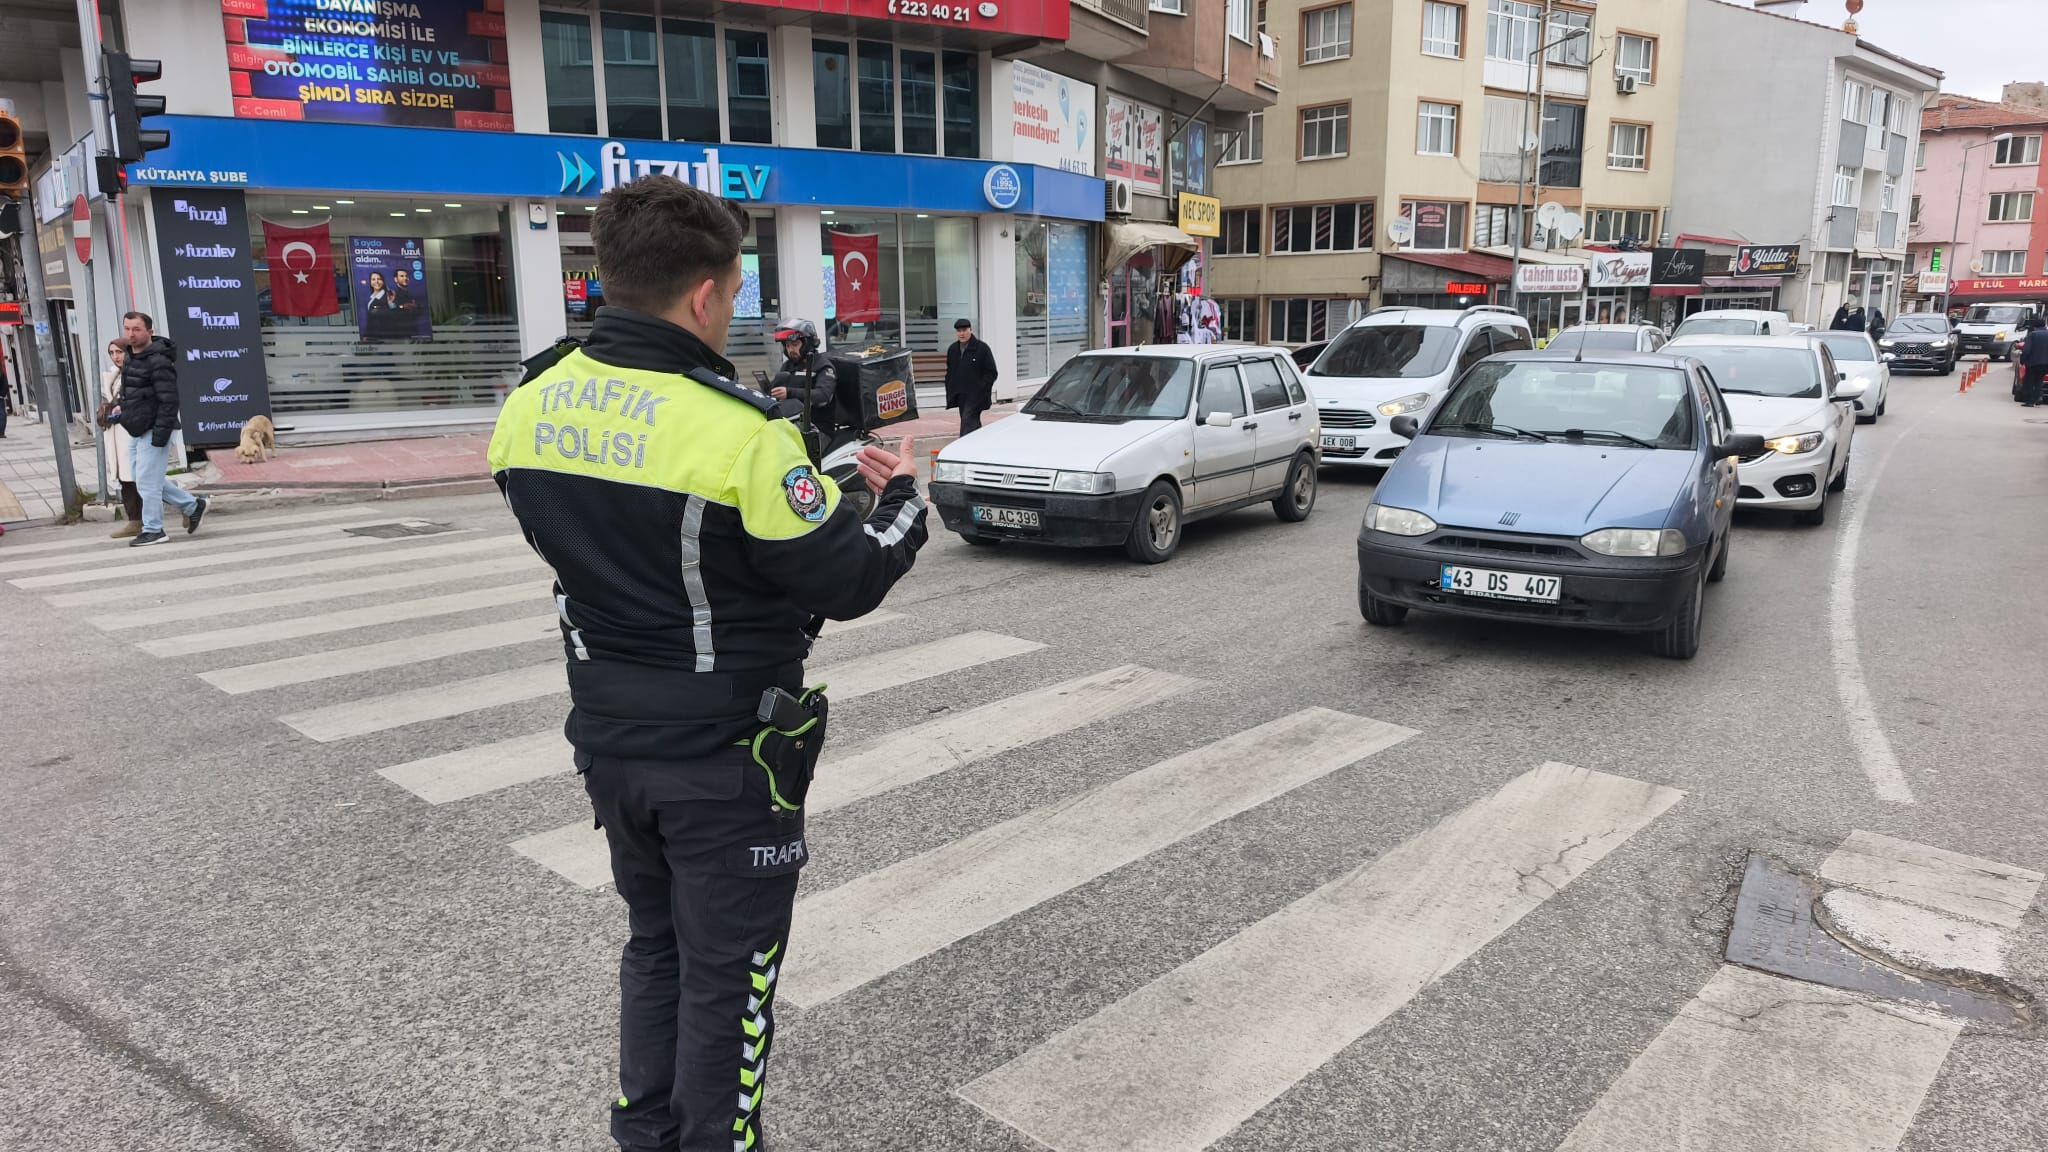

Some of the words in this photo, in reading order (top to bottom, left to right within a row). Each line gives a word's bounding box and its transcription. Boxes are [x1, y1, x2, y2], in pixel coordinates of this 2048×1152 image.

[315, 0, 422, 19] DAYANIŞMA
[900, 0, 928, 17] 223
[931, 4, 950, 19] 40
[953, 6, 970, 21] 21
[304, 17, 407, 40] EKONOMİSİ
[411, 23, 436, 43] İLE
[283, 35, 370, 59] BİNLERCE
[373, 42, 407, 65] KİŞİ
[411, 48, 433, 64] EV
[437, 50, 460, 66] VE
[263, 59, 364, 82] OTOMOBİL
[366, 66, 425, 86] SAHİBİ
[428, 72, 481, 90] OLDU.
[298, 81, 351, 104] ŞİMDİ
[354, 87, 397, 106] SIRA
[400, 88, 455, 109] SİZDE!
[136, 167, 206, 182] KÜTAHYA
[209, 171, 248, 184] ŞUBE
[189, 205, 228, 225] fuzul
[355, 248, 390, 256] arabamı
[401, 248, 421, 256] fuzul
[1523, 266, 1554, 282] tahsin
[1557, 267, 1578, 282] usta
[203, 351, 240, 359] NEVITA
[539, 378, 671, 427] TRAFİK
[878, 389, 905, 402] BURGER
[879, 397, 905, 413] KING
[535, 422, 648, 469] POLİSİ
[1340, 438, 1354, 447] 008
[979, 508, 993, 521] 26
[998, 509, 1015, 523] AC
[1016, 511, 1038, 525] 399
[1453, 569, 1473, 588] 43
[1487, 573, 1509, 592] DS
[1525, 577, 1558, 597] 407
